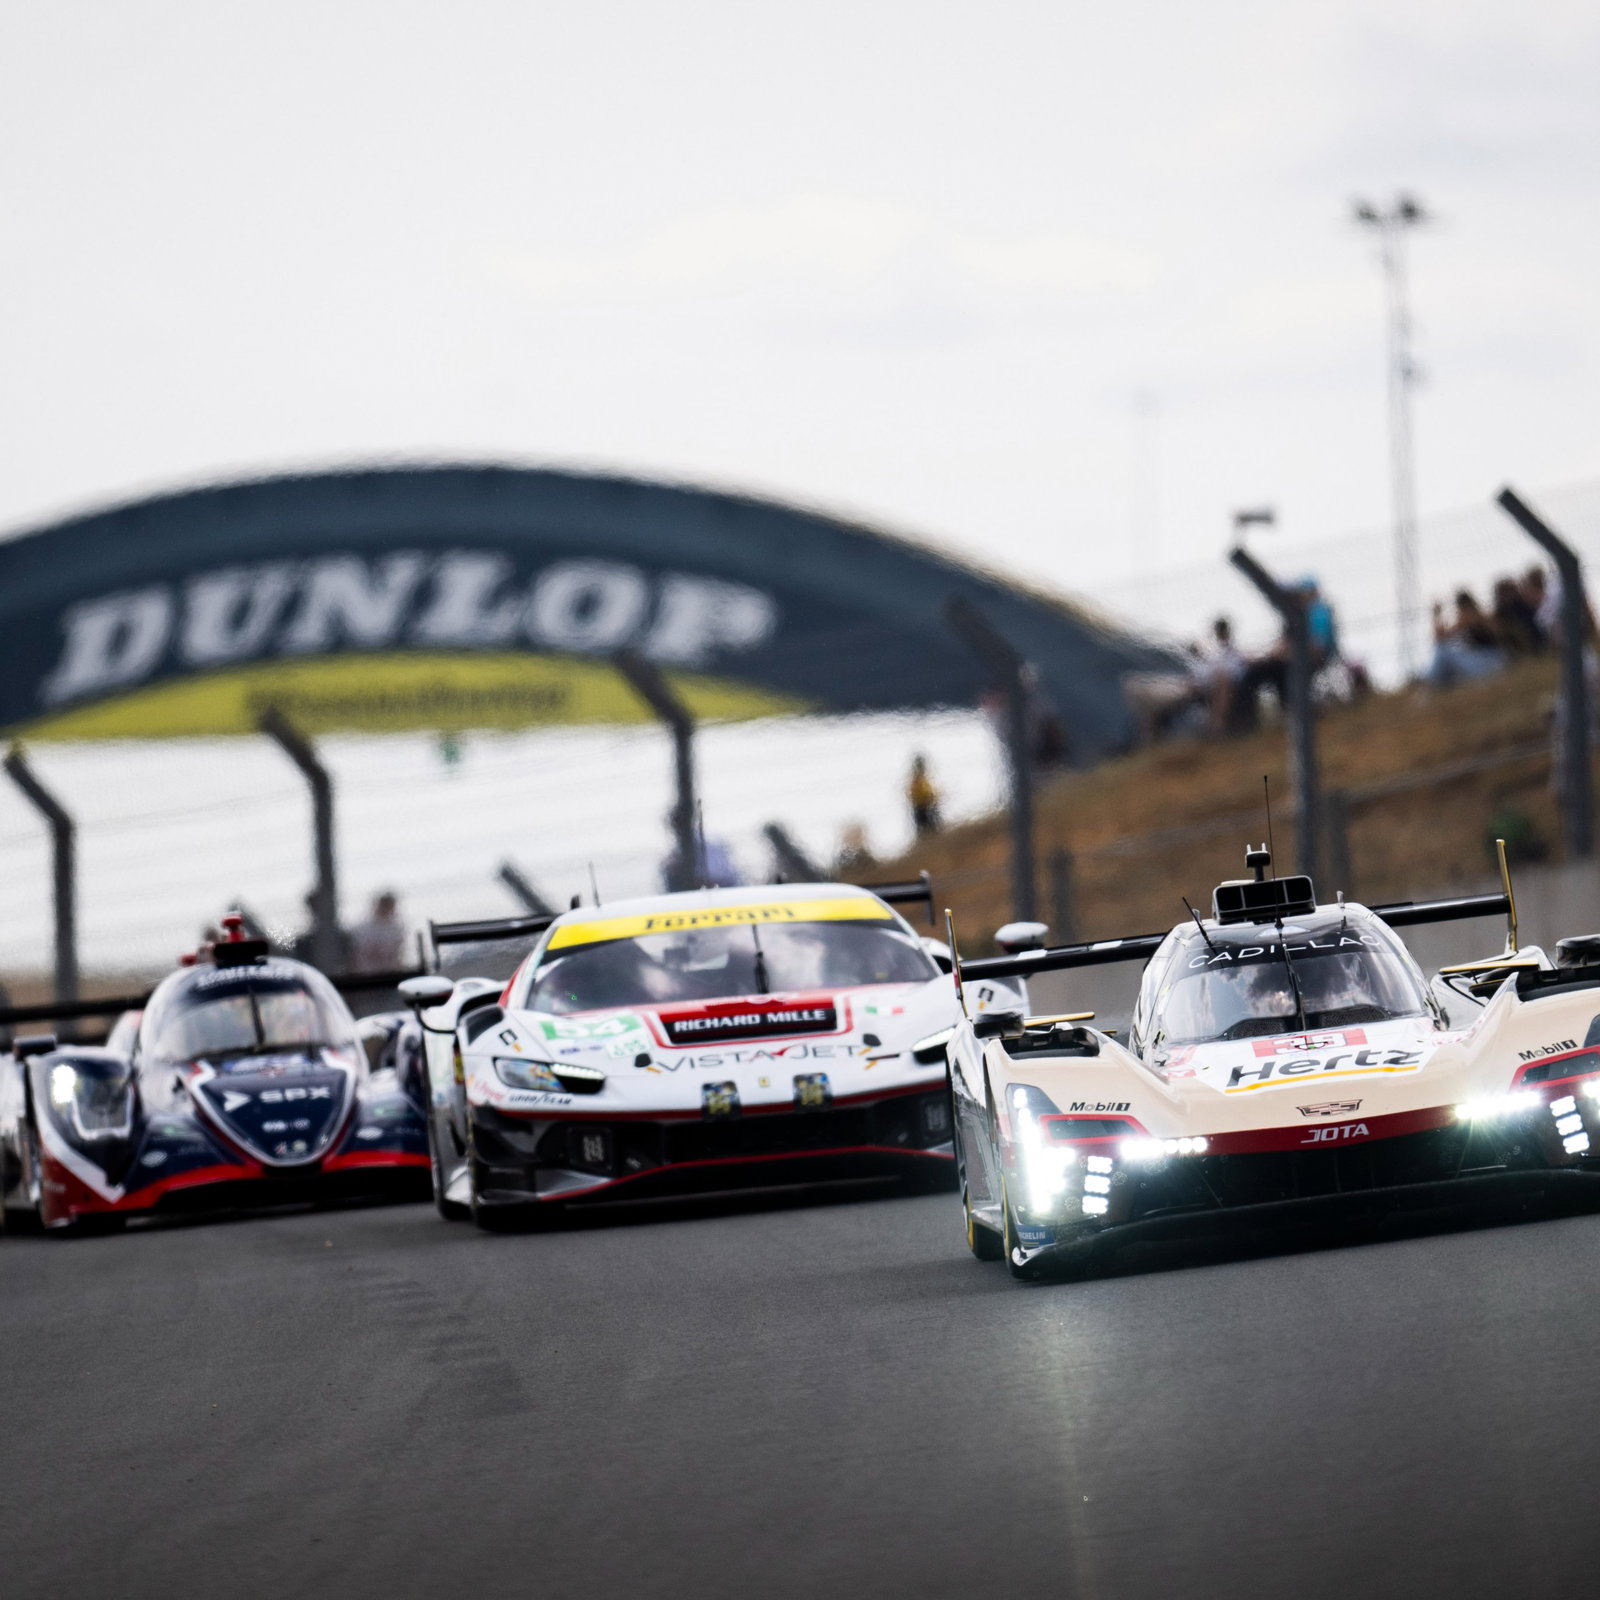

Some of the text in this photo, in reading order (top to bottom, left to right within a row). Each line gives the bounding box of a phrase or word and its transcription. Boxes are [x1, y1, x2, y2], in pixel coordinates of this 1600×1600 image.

[44, 551, 770, 698] DUNLOP
[646, 907, 795, 929] Ferrari
[1188, 936, 1381, 968] CADILLAC
[674, 1009, 827, 1032] RICHARD MILLE
[1226, 1047, 1424, 1087] Hertz
[1300, 1123, 1370, 1143] JOTA
